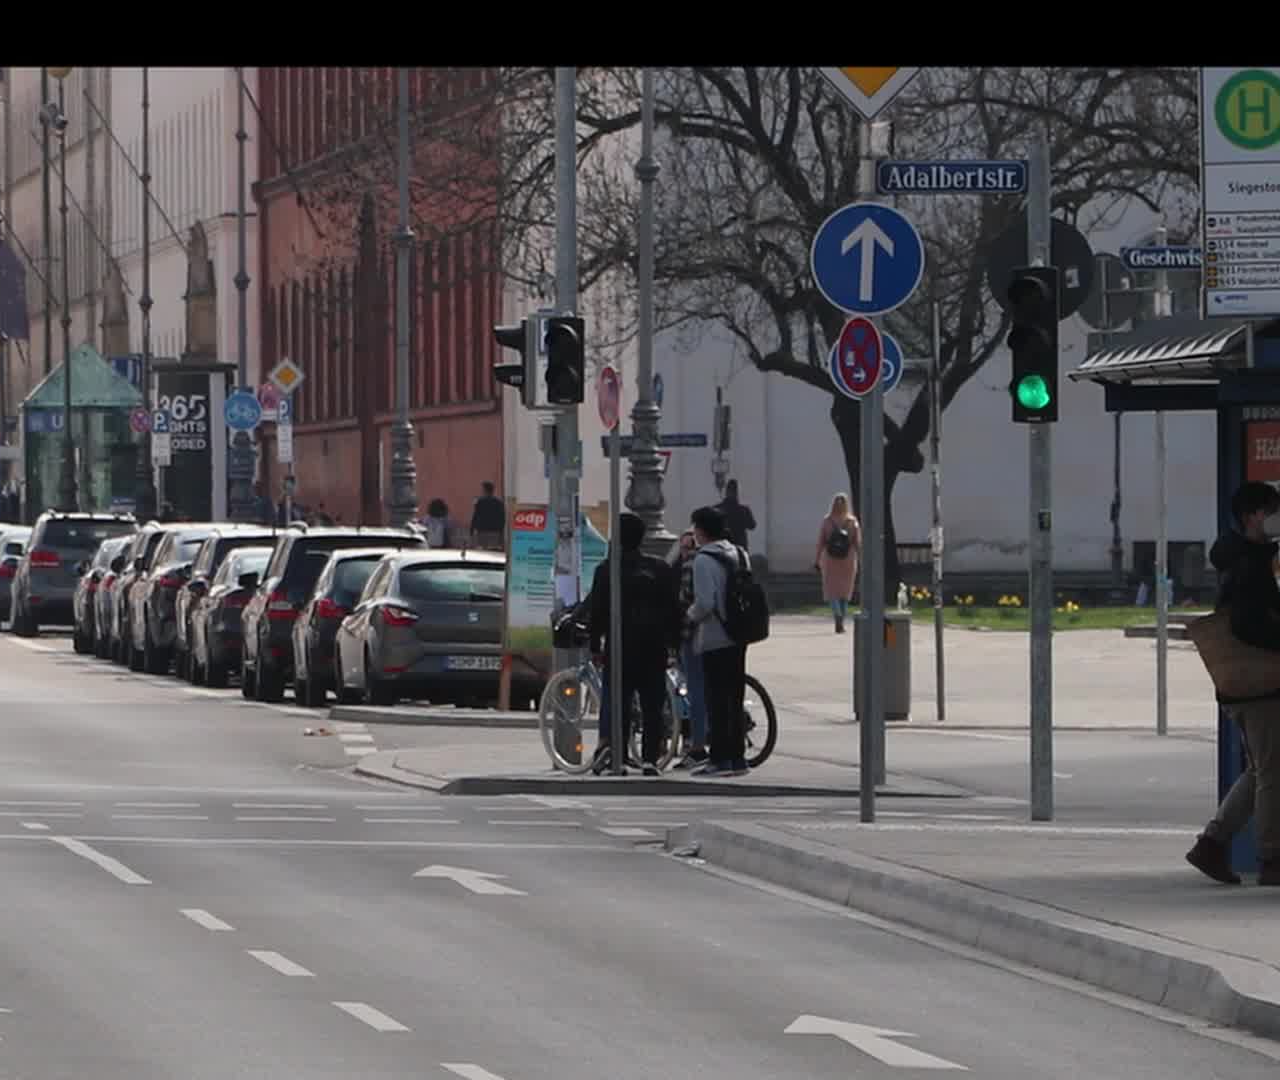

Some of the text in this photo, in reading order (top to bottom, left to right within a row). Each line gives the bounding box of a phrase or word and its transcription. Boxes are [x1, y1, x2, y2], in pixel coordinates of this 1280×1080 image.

[887, 165, 1019, 189] Adalbertstr.
[1129, 249, 1201, 267] Geschwis
[160, 394, 207, 420] 365
[154, 412, 166, 428] P
[170, 421, 207, 433] GHTS
[171, 438, 207, 449] OSED
